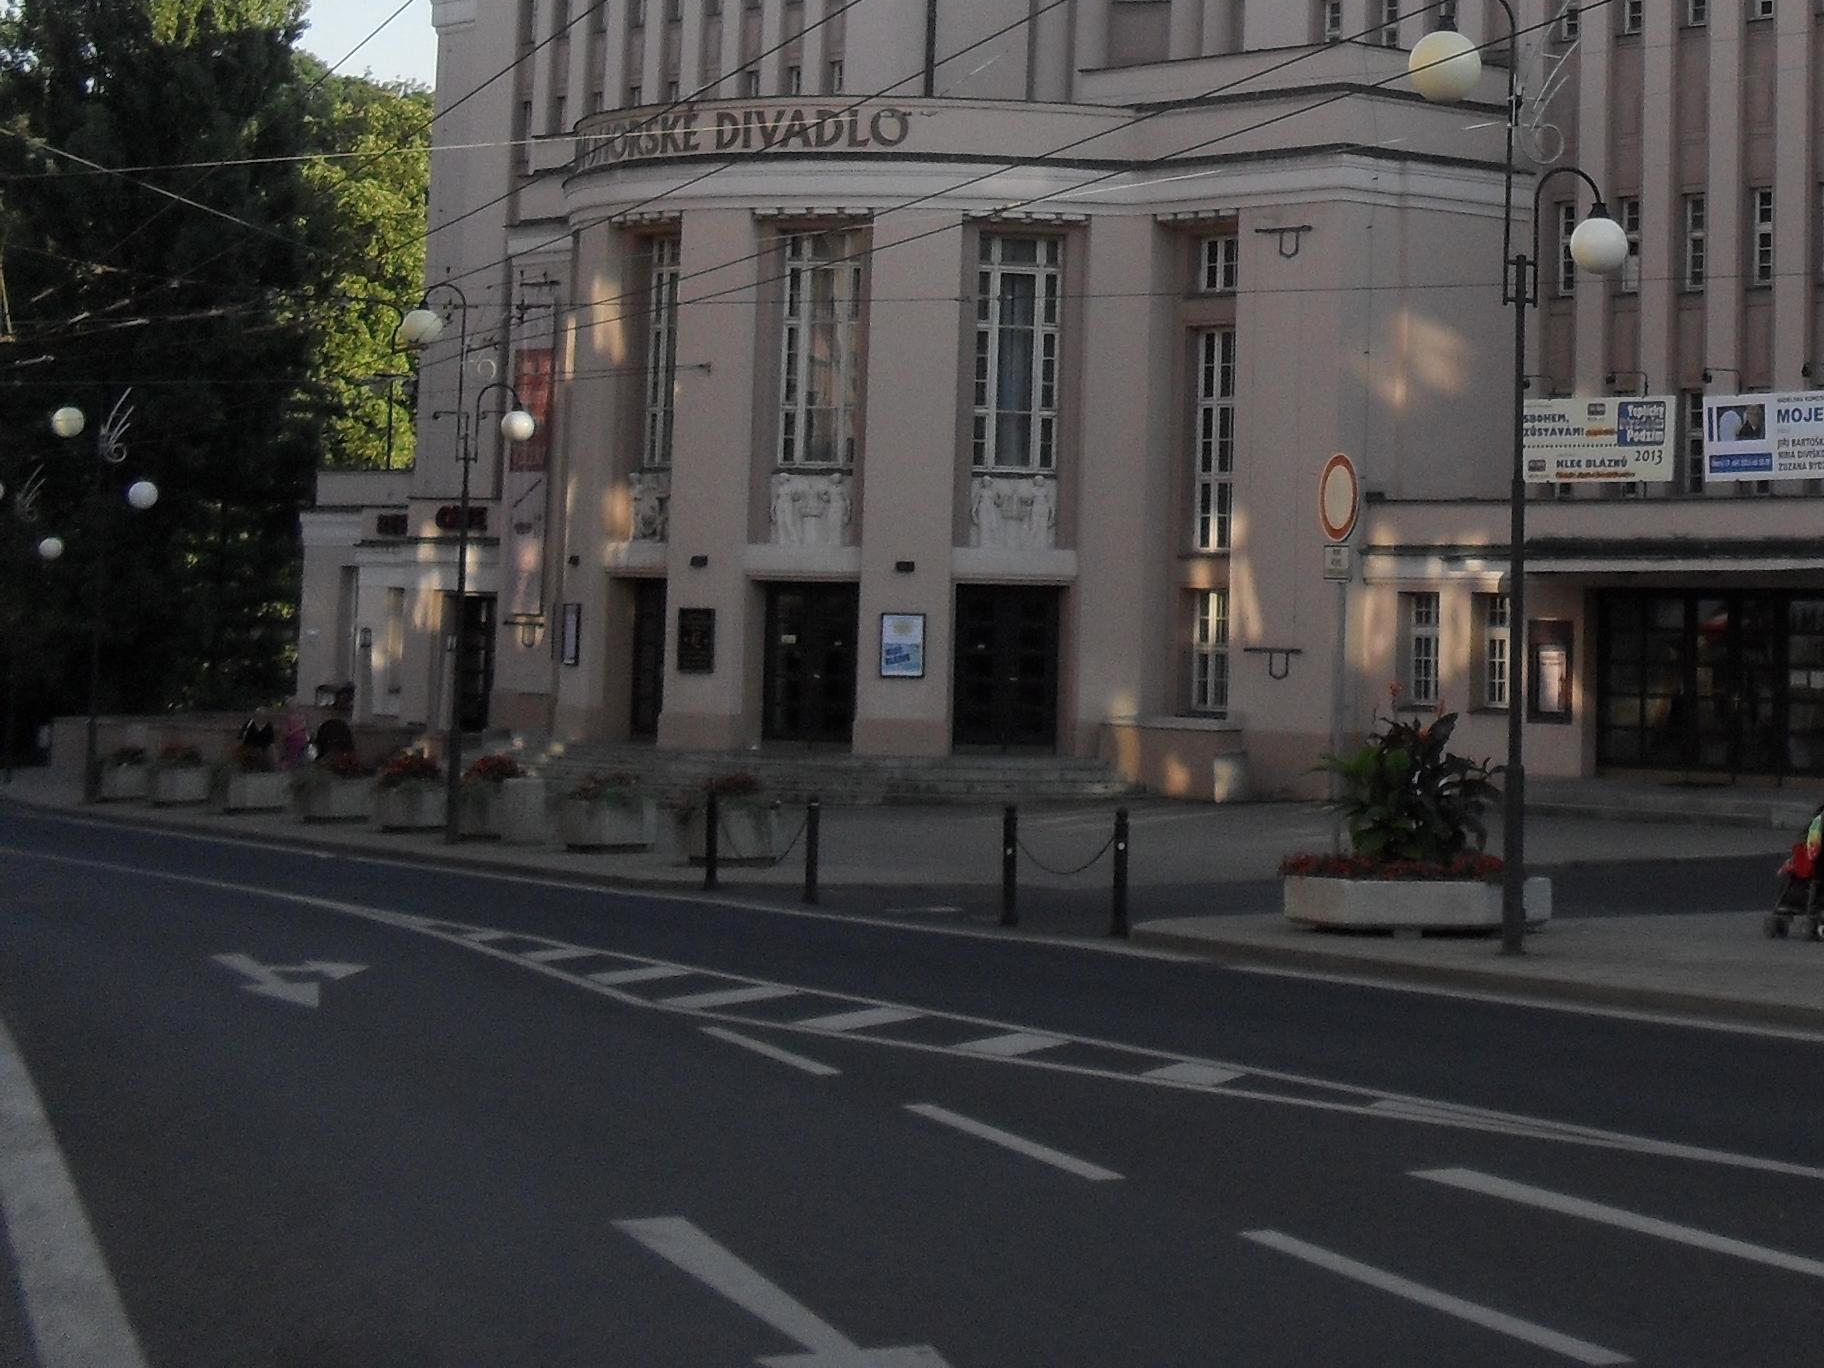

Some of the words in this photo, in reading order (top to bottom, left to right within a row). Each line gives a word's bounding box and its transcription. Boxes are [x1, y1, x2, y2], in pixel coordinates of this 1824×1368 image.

[715, 108, 909, 150] DIVADLO
[1776, 407, 1824, 424] MOJE
[1634, 449, 1664, 465] 2013
